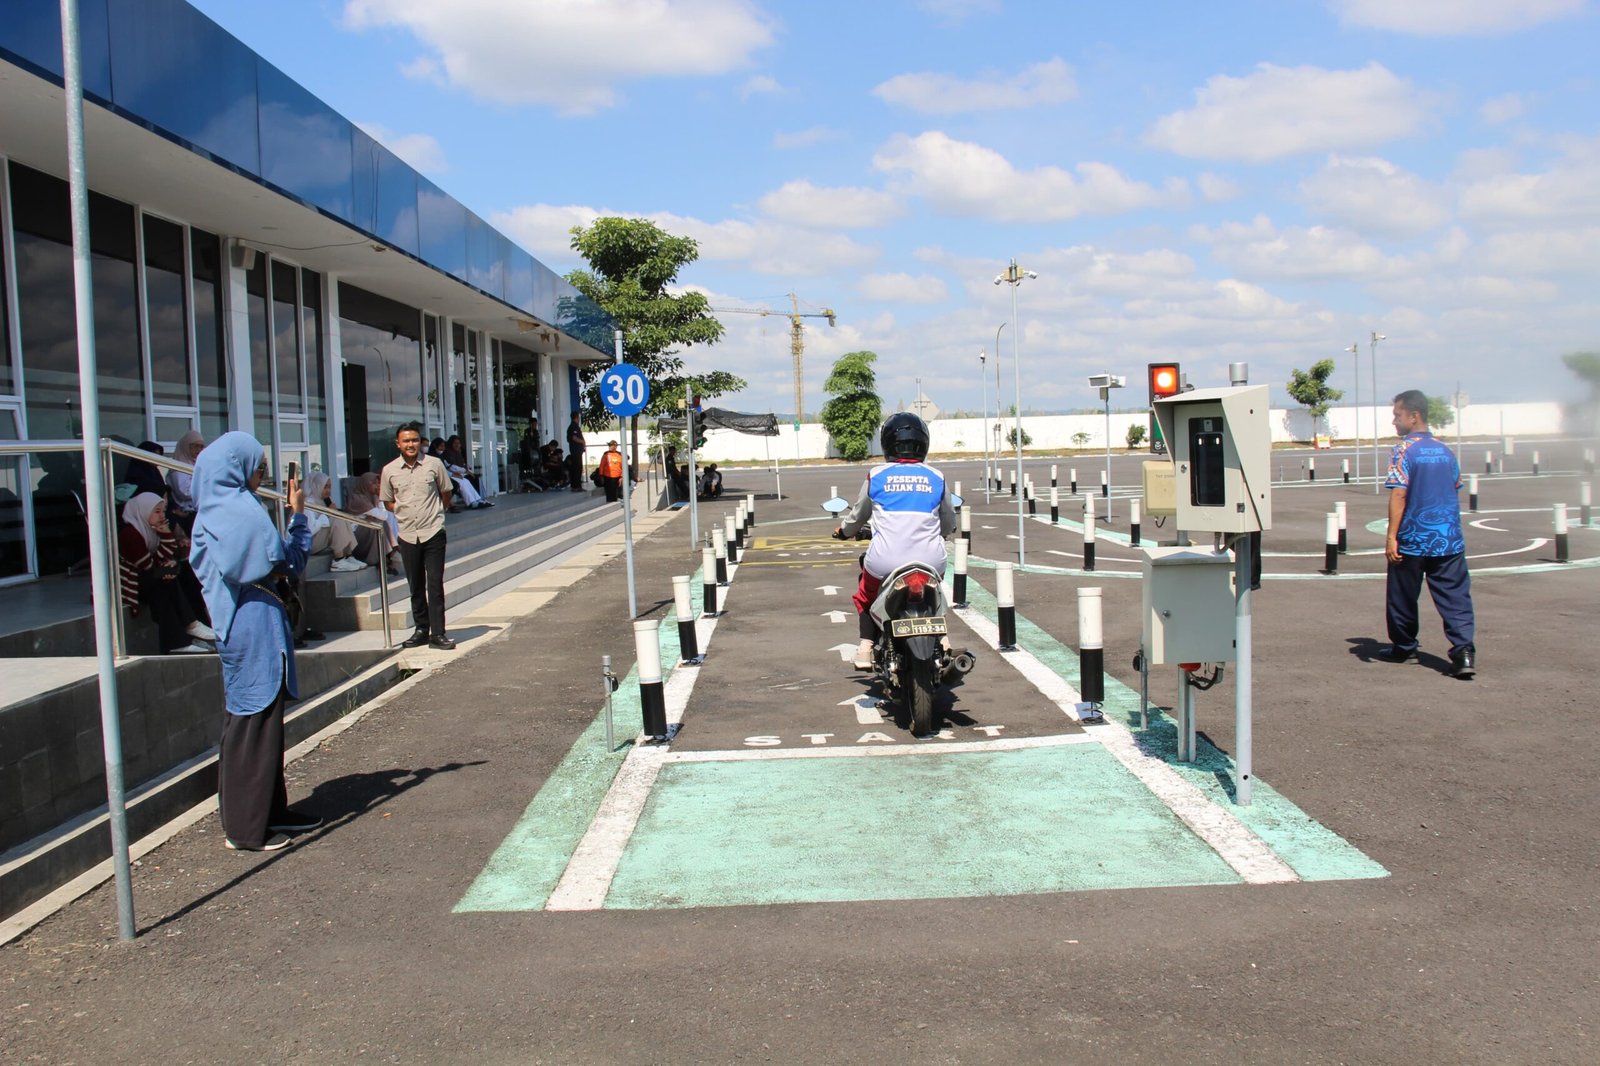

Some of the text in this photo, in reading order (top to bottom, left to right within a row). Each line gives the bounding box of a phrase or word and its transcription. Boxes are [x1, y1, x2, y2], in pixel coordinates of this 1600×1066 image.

[607, 374, 644, 405] 30
[886, 475, 929, 484] PESERTA
[884, 484, 932, 493] UJIAN SIM
